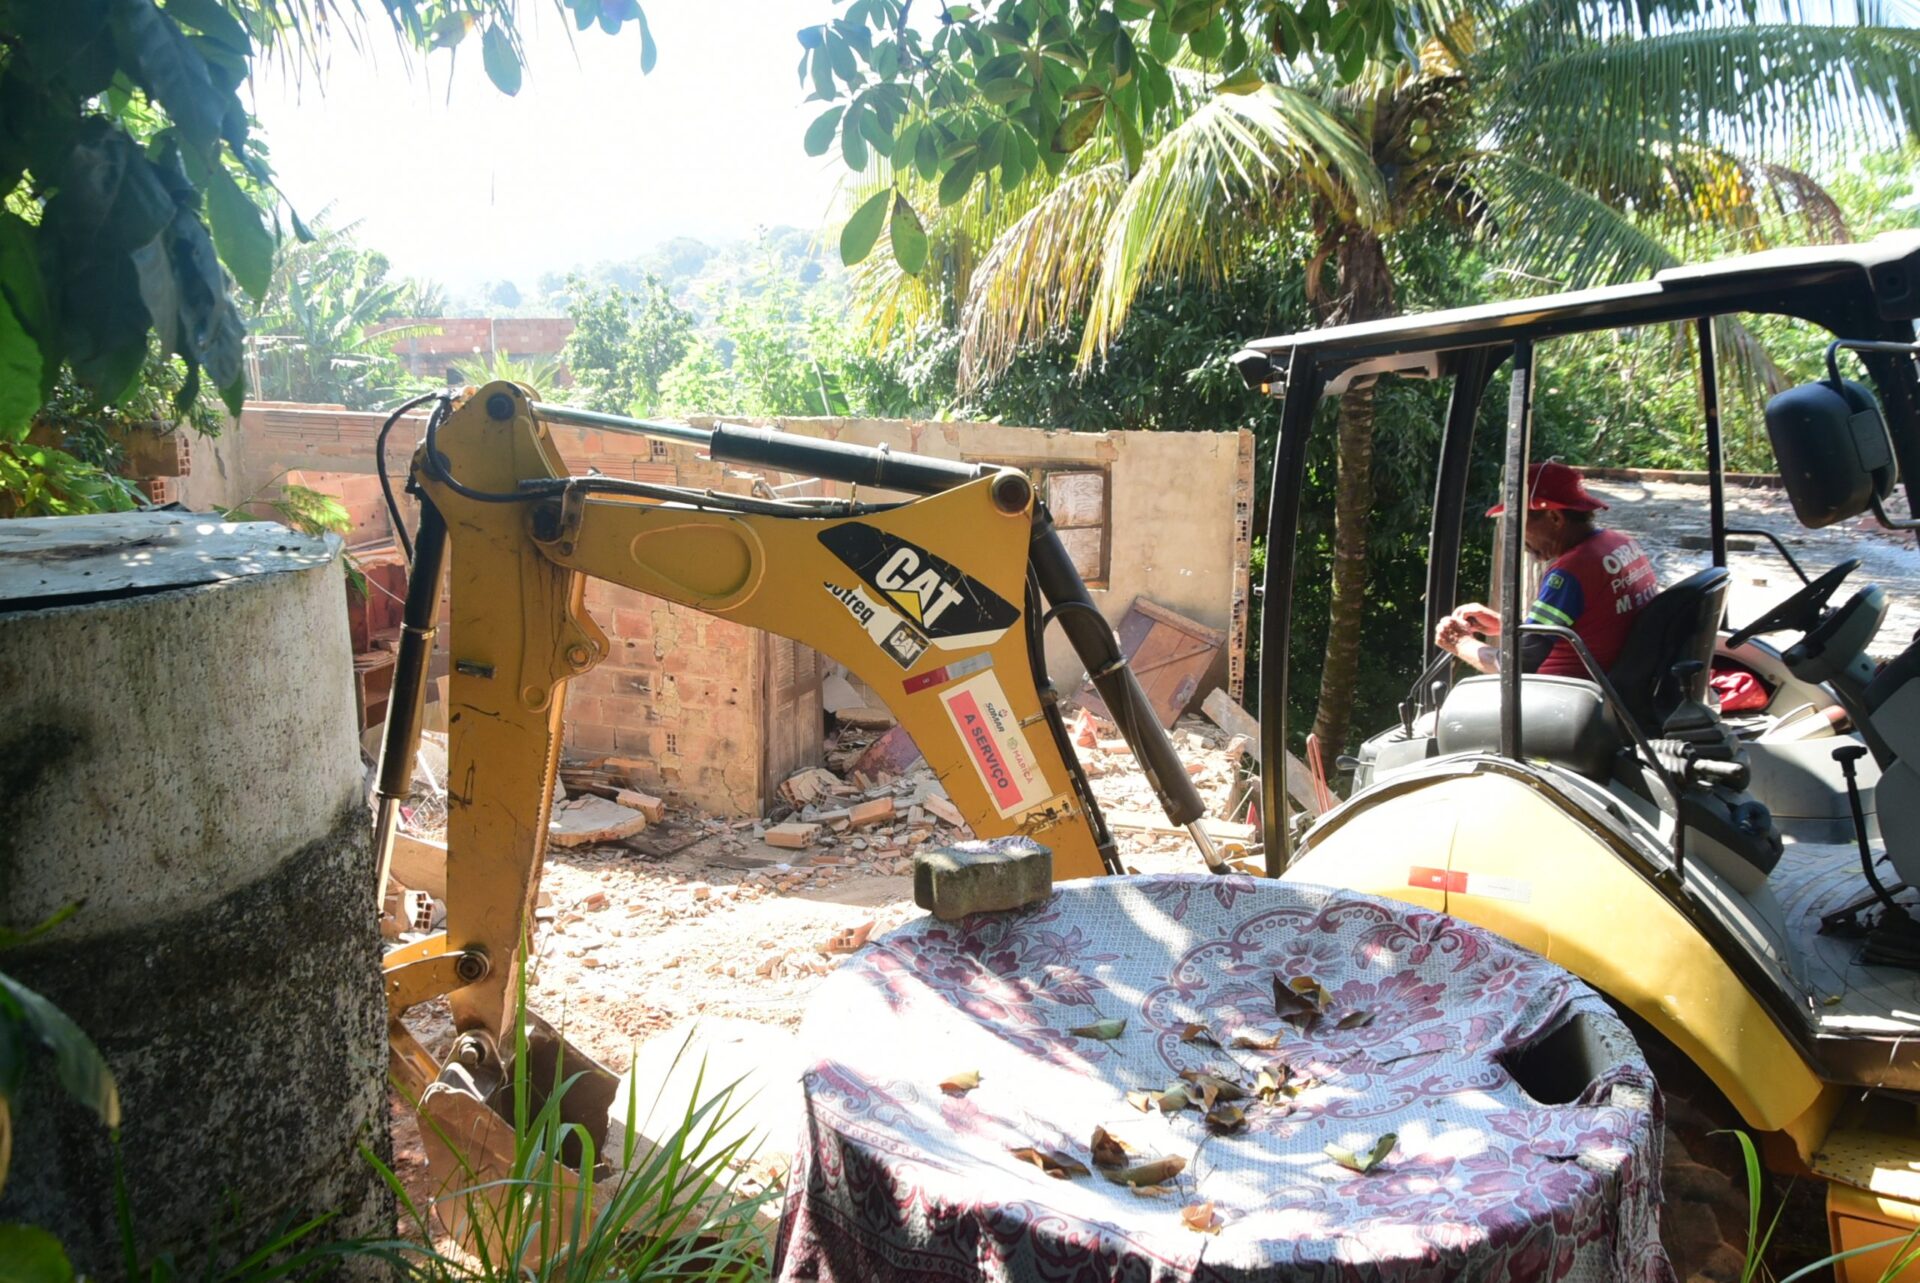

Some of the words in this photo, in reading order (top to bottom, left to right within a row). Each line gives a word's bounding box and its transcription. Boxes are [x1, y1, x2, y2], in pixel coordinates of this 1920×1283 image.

[875, 547, 964, 629] CAT
[890, 629, 924, 659] CAT
[965, 714, 975, 725] A
[972, 727, 1009, 789] SERVIÇO
